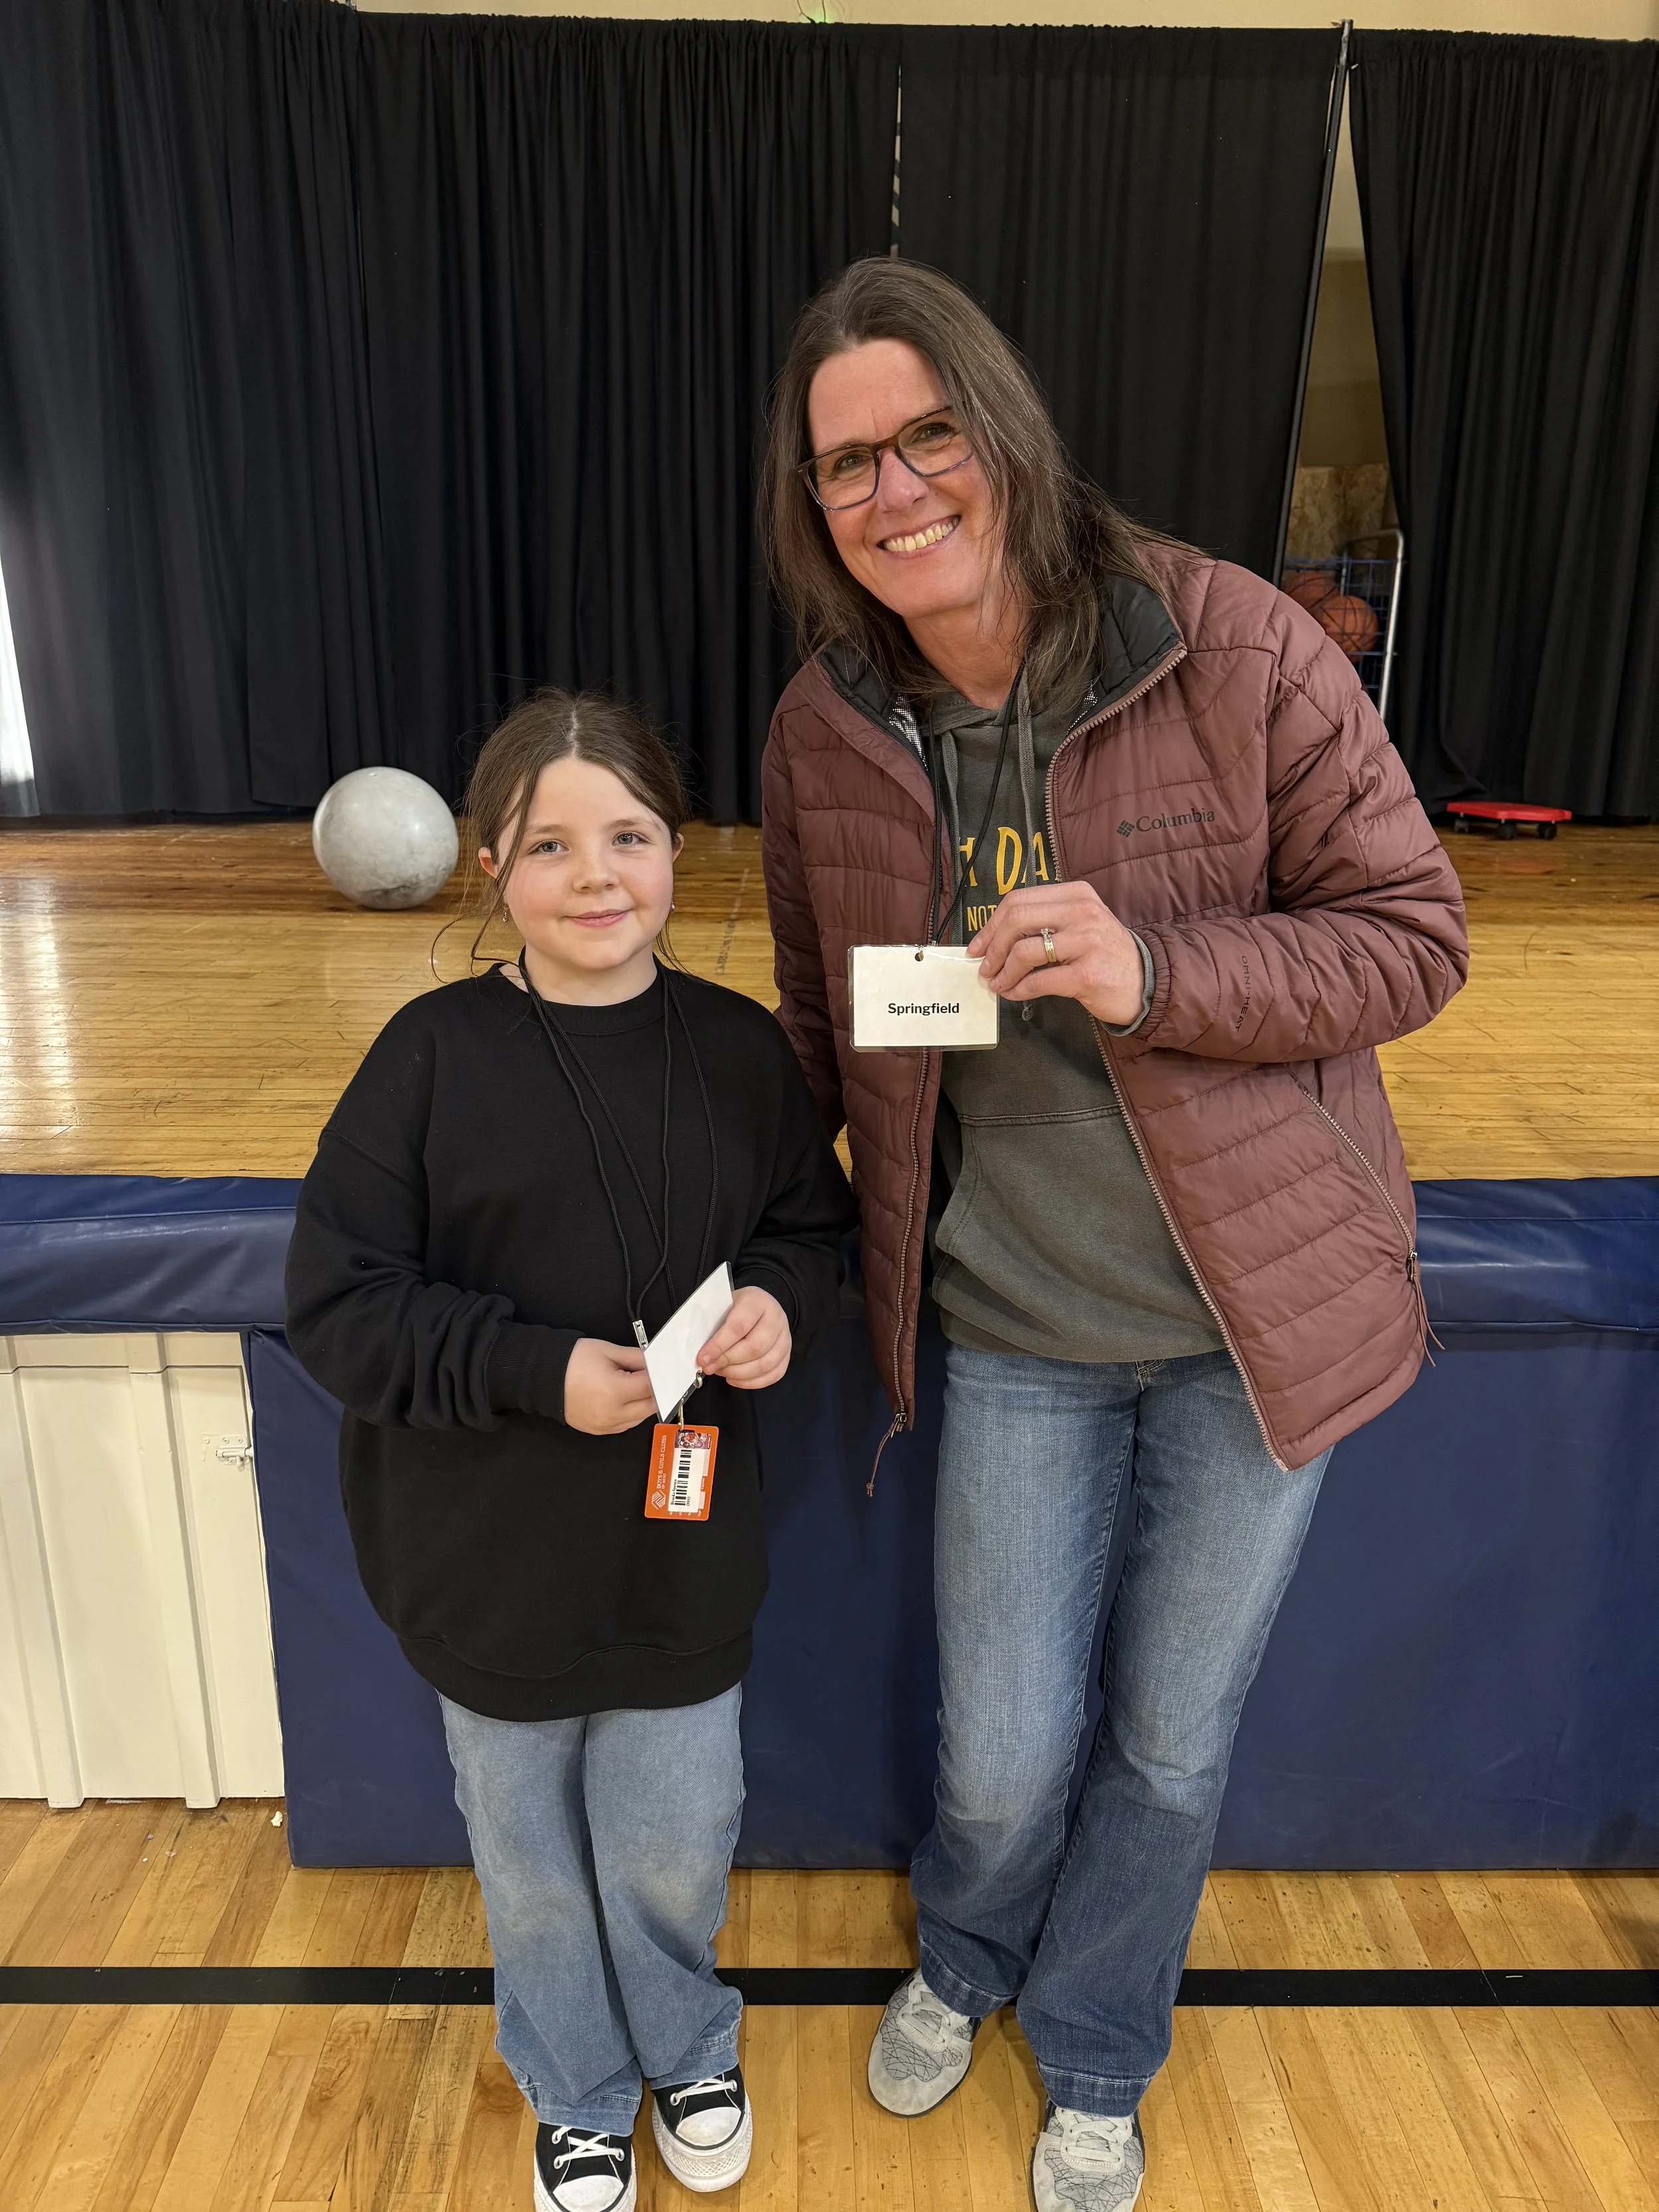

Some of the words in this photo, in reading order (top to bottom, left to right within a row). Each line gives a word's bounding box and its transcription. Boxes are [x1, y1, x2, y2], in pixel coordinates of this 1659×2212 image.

[1135, 807, 1215, 832] Columbia
[996, 826, 1059, 895] DA
[888, 1003, 960, 1015] Springfield
[1235, 956, 1252, 1032] OMNI-HEAT
